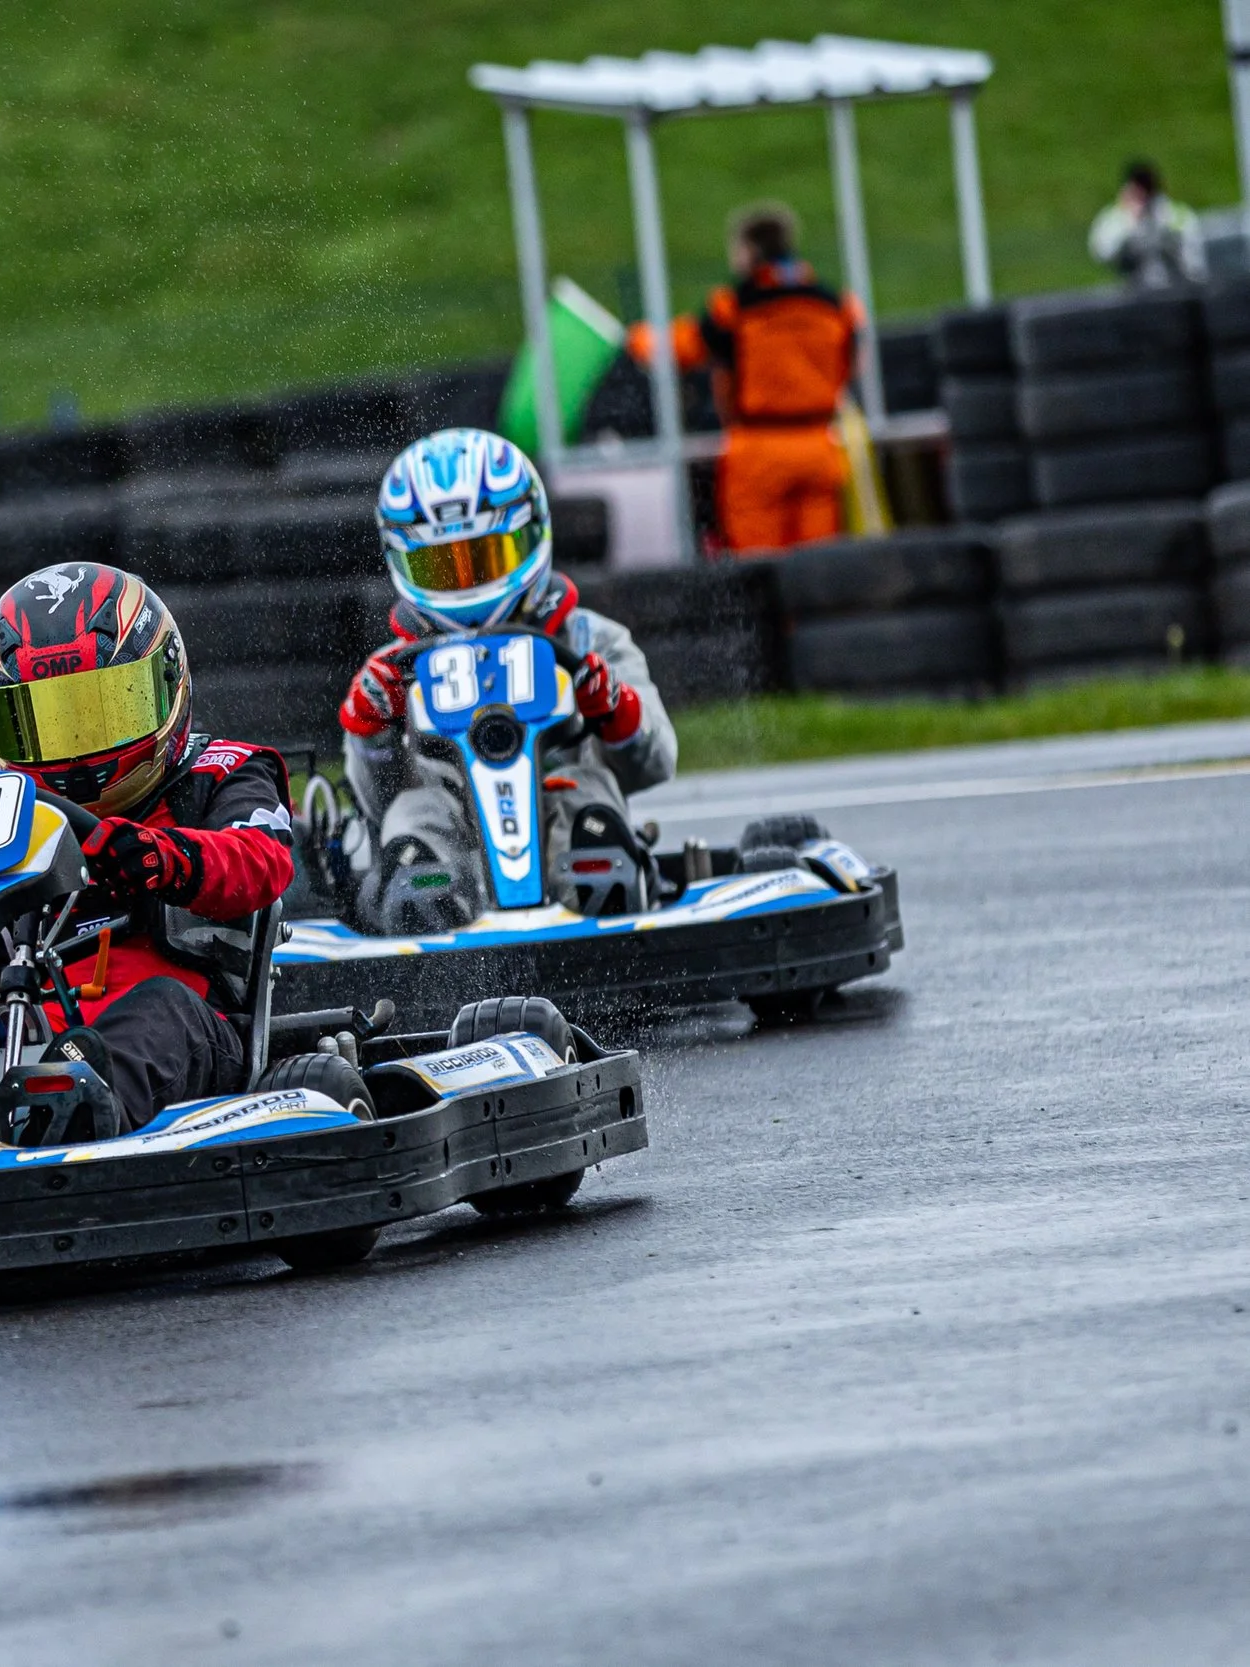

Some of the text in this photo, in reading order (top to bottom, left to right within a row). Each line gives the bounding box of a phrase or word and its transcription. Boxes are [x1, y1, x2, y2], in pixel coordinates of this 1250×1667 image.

[32, 655, 82, 679] OMP
[429, 635, 535, 713] 31
[195, 754, 236, 767] OMP
[495, 781, 519, 836] DRS
[63, 1042, 82, 1061] OMP
[425, 1046, 499, 1074] RICCIARDO
[268, 1100, 309, 1114] KART
